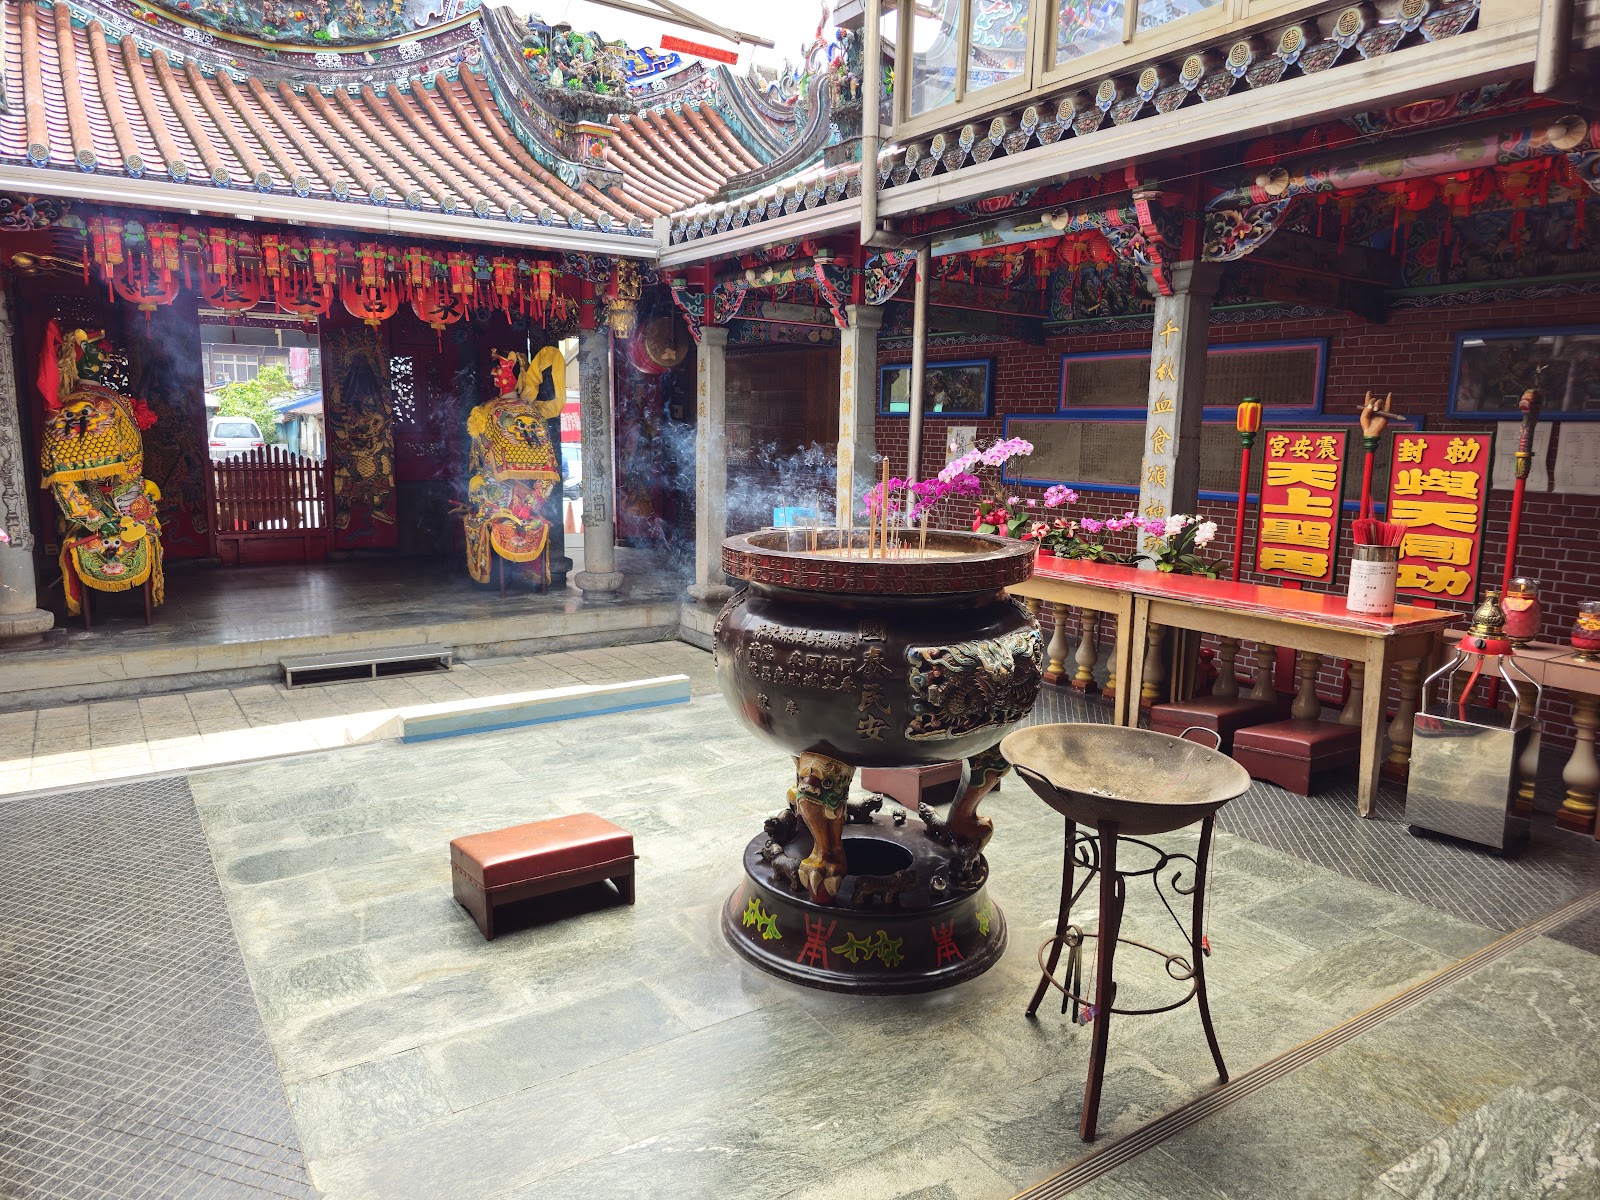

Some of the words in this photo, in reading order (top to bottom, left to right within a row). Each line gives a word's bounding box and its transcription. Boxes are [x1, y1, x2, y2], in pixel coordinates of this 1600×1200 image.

[1269, 434, 1341, 461] 震安宮
[1259, 461, 1338, 578] 天上聖母
[1389, 468, 1481, 596] 與天同功
[855, 620, 893, 742] 國泰民安
